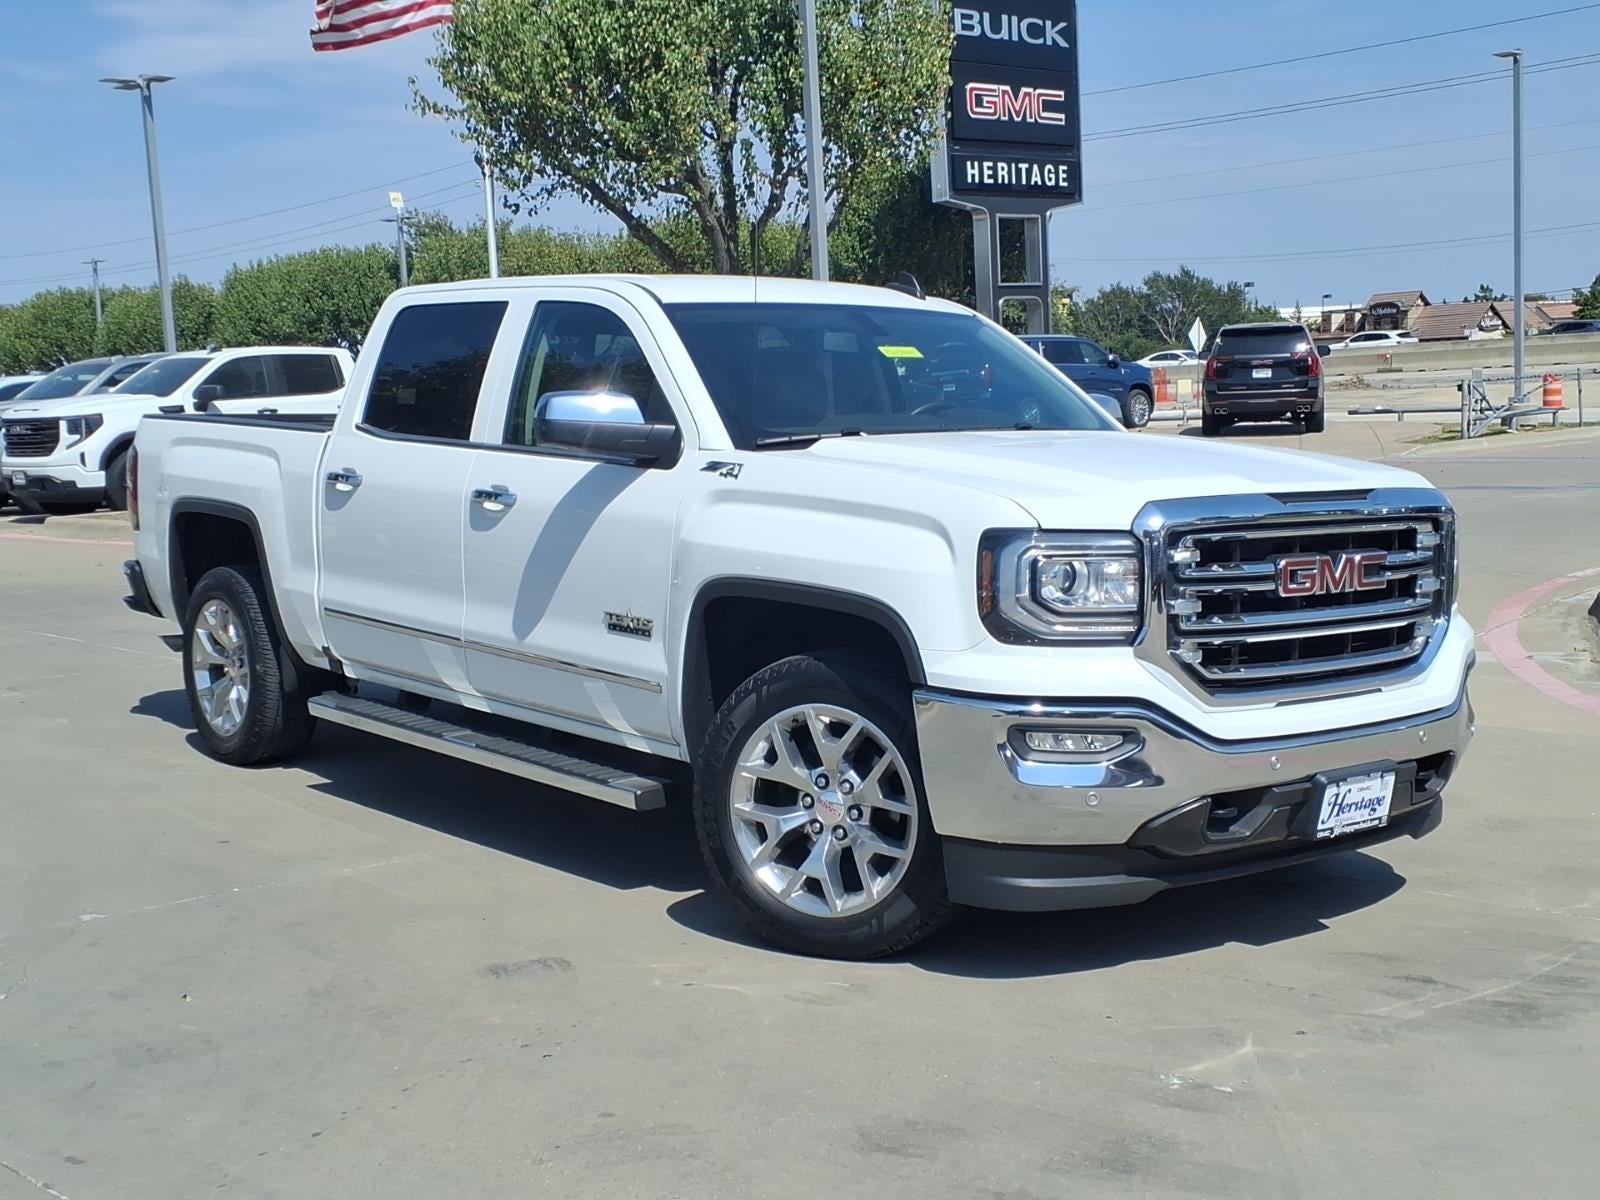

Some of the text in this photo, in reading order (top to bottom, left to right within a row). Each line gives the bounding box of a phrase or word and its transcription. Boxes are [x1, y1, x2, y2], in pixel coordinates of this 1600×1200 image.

[953, 7, 1070, 48] BUICK
[965, 82, 1066, 126] GMC
[966, 160, 1069, 187] HERITAGE
[1279, 550, 1388, 598] GMC
[1321, 788, 1386, 825] Heritage
